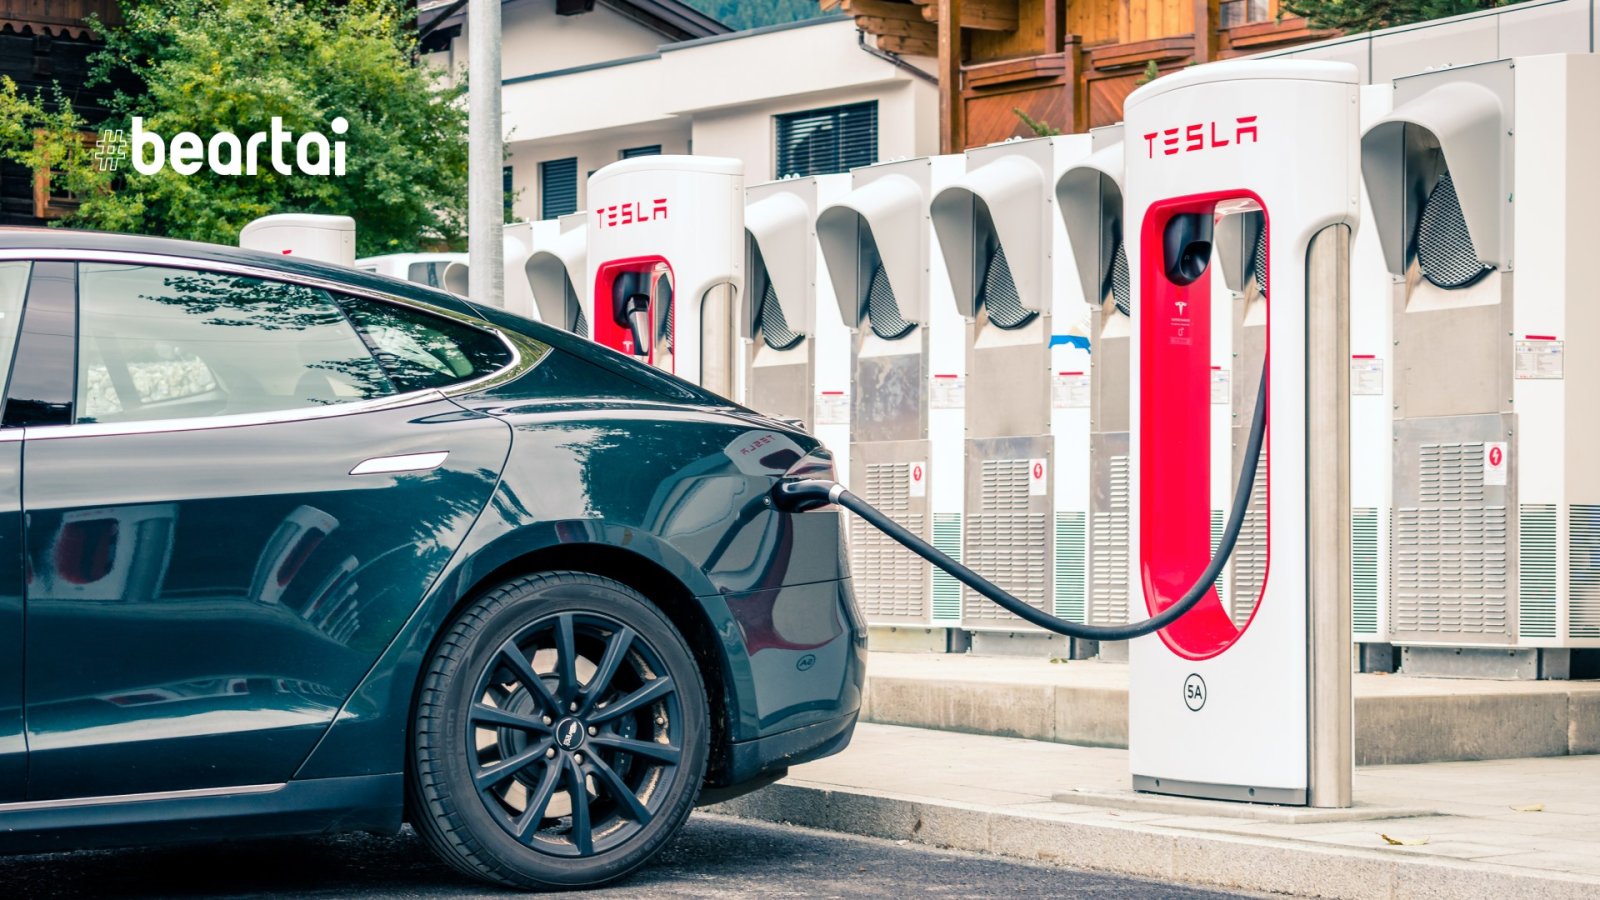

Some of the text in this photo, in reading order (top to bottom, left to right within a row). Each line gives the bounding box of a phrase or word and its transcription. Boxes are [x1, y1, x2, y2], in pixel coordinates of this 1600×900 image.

[1144, 116, 1258, 159] TESLA
[596, 198, 668, 228] TESLA
[1187, 684, 1203, 700] 5A
